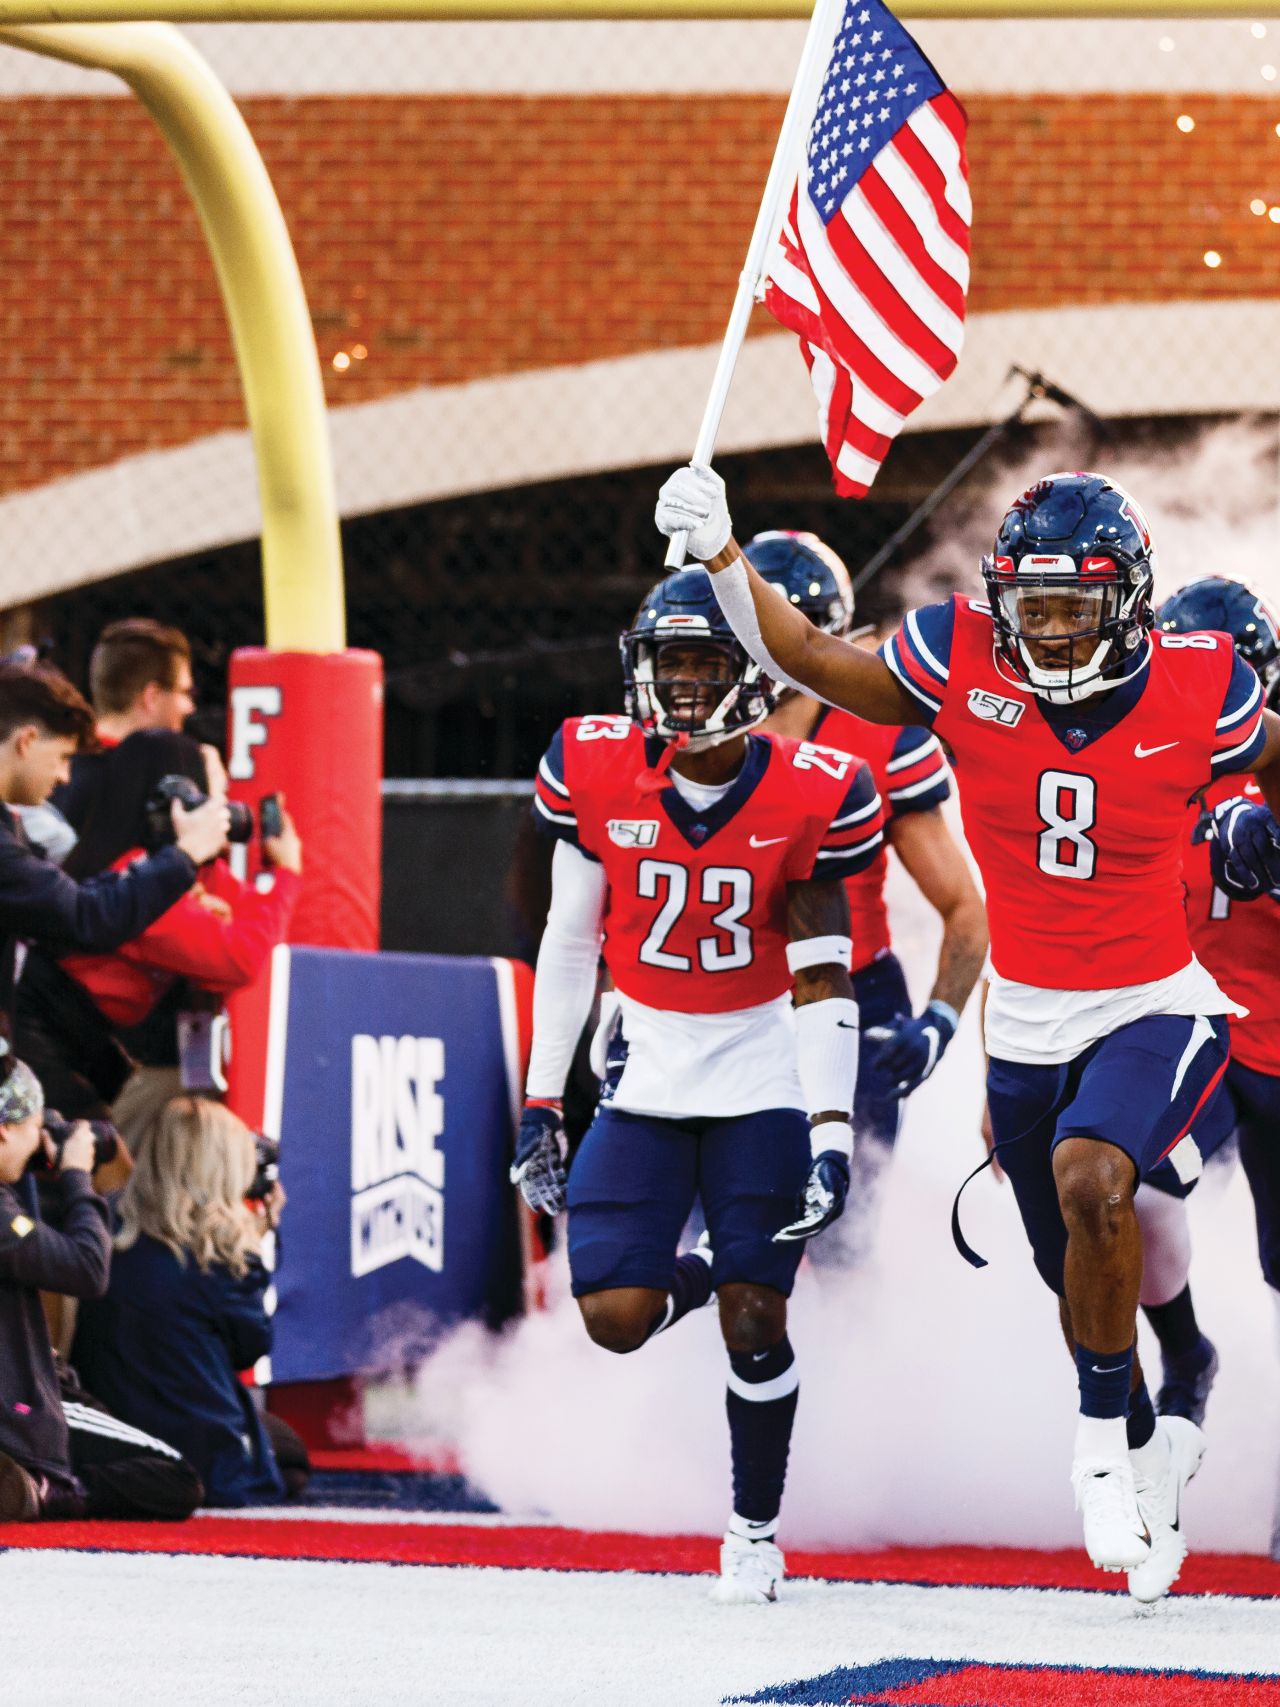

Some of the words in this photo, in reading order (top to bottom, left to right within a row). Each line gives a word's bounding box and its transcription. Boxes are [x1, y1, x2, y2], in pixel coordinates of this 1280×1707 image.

[1161, 635, 1218, 650] 8
[969, 690, 1023, 725] 150
[606, 820, 659, 847] 150
[1037, 768, 1097, 880] 8
[638, 859, 753, 973] 23
